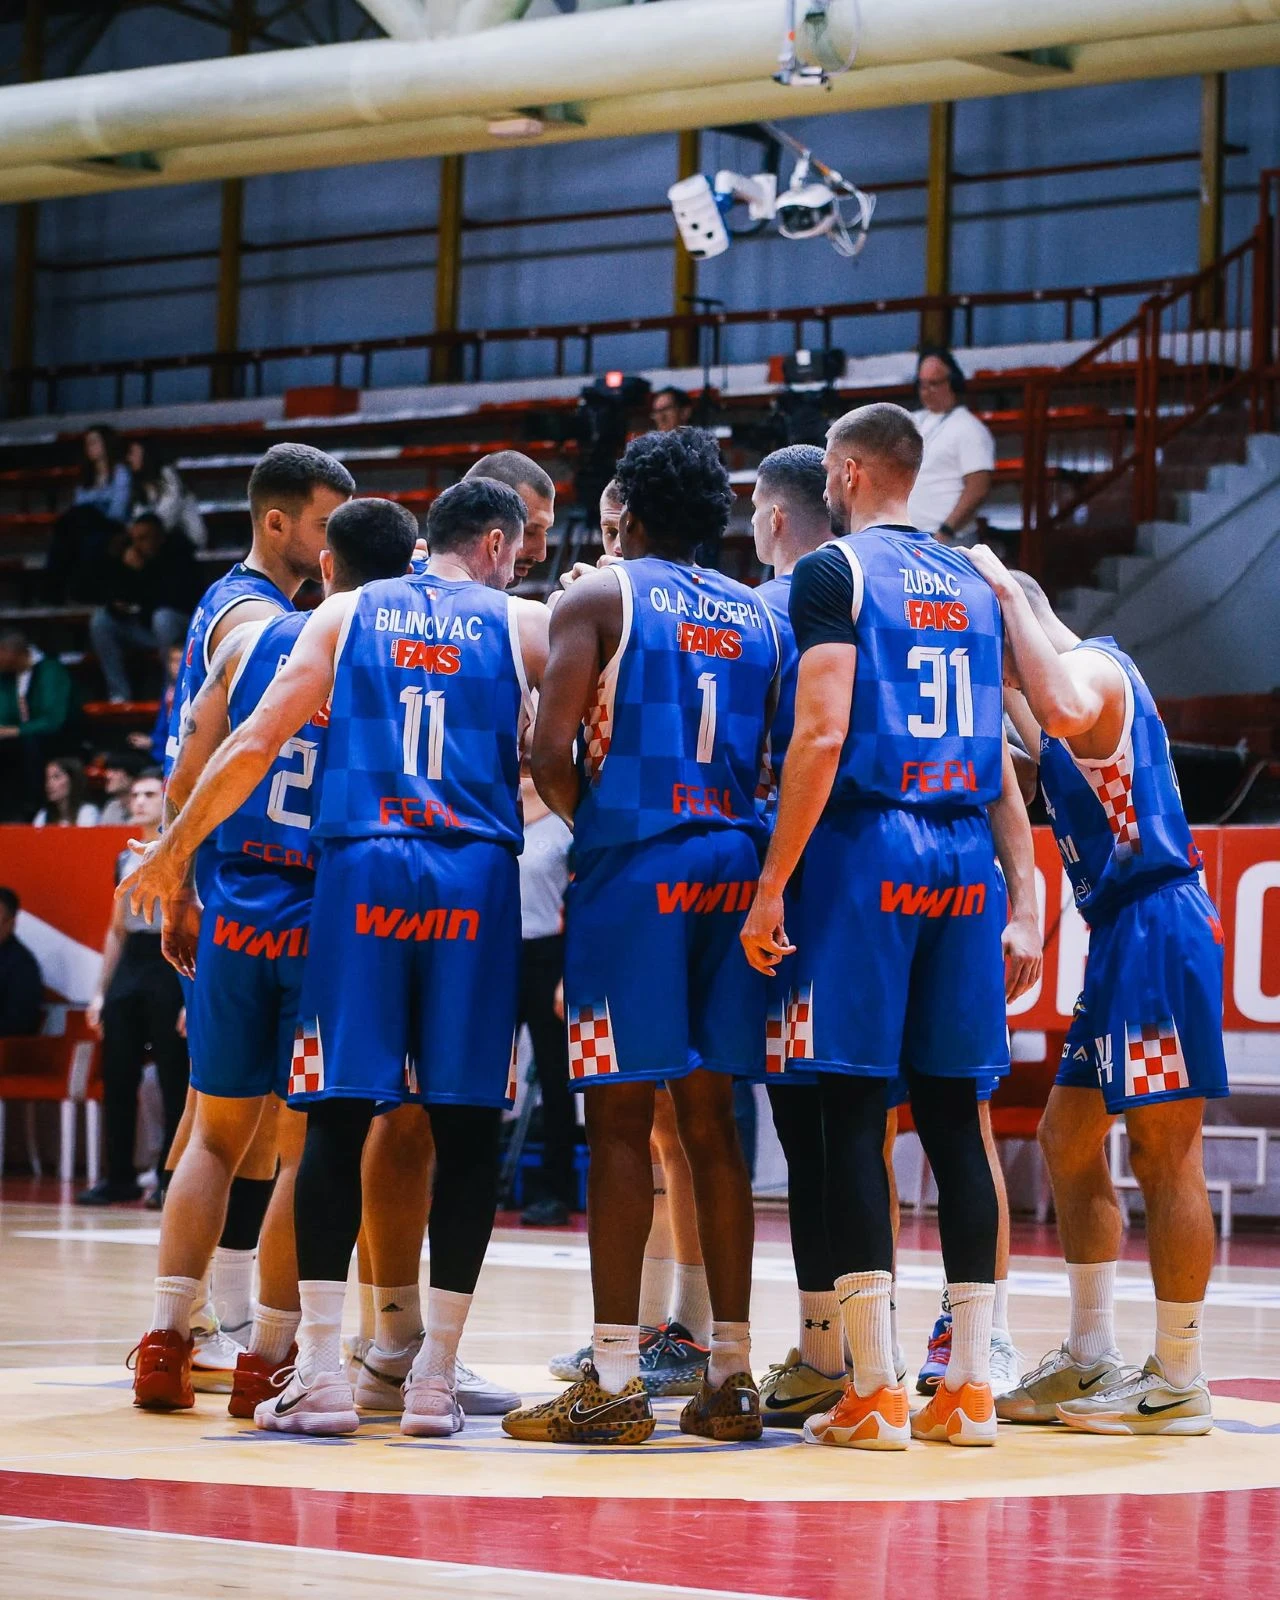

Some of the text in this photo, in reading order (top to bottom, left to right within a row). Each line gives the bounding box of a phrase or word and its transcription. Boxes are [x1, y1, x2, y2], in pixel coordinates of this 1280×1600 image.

[899, 568, 961, 597] ZUBAC
[374, 607, 483, 641] BILINOVAC
[650, 587, 762, 629] OLA-JOSEPH
[908, 599, 969, 633] FAKS
[394, 638, 461, 676] FAKS
[679, 621, 743, 660] FAKS
[907, 646, 974, 739] 31
[399, 685, 446, 780] 11
[696, 672, 717, 764] 1
[267, 736, 318, 830] 2
